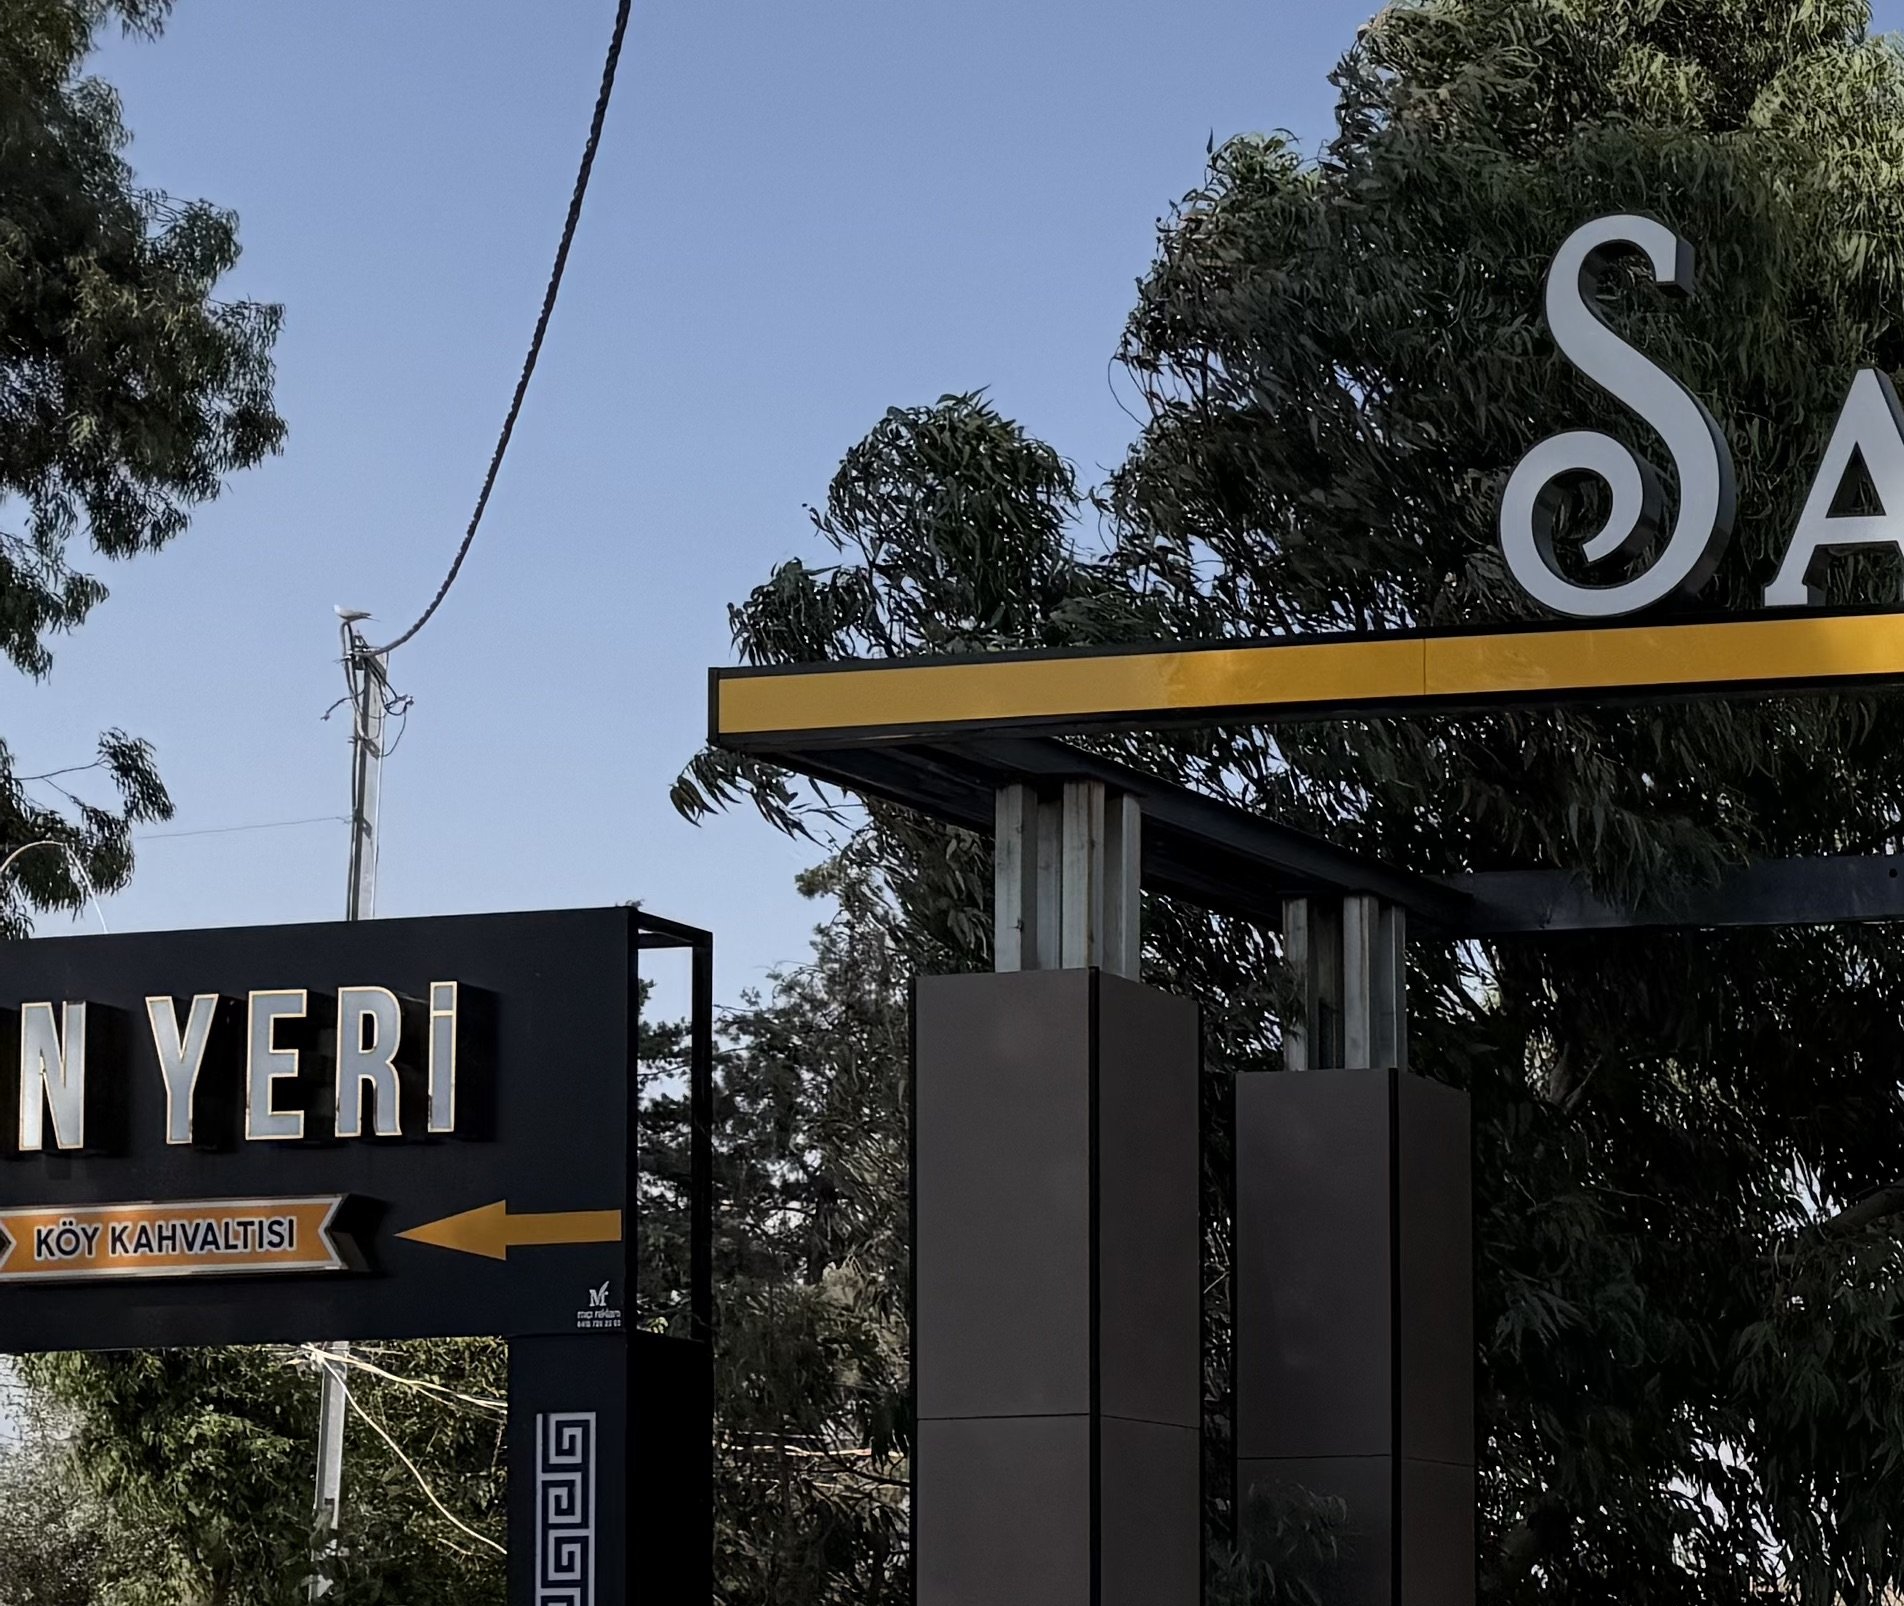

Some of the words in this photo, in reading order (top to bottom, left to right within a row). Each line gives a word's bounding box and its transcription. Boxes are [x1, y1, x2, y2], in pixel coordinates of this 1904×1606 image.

[145, 980, 458, 1145] YERİ
[35, 1218, 101, 1260] KÖY
[109, 1216, 295, 1256] KAHVALTISI
